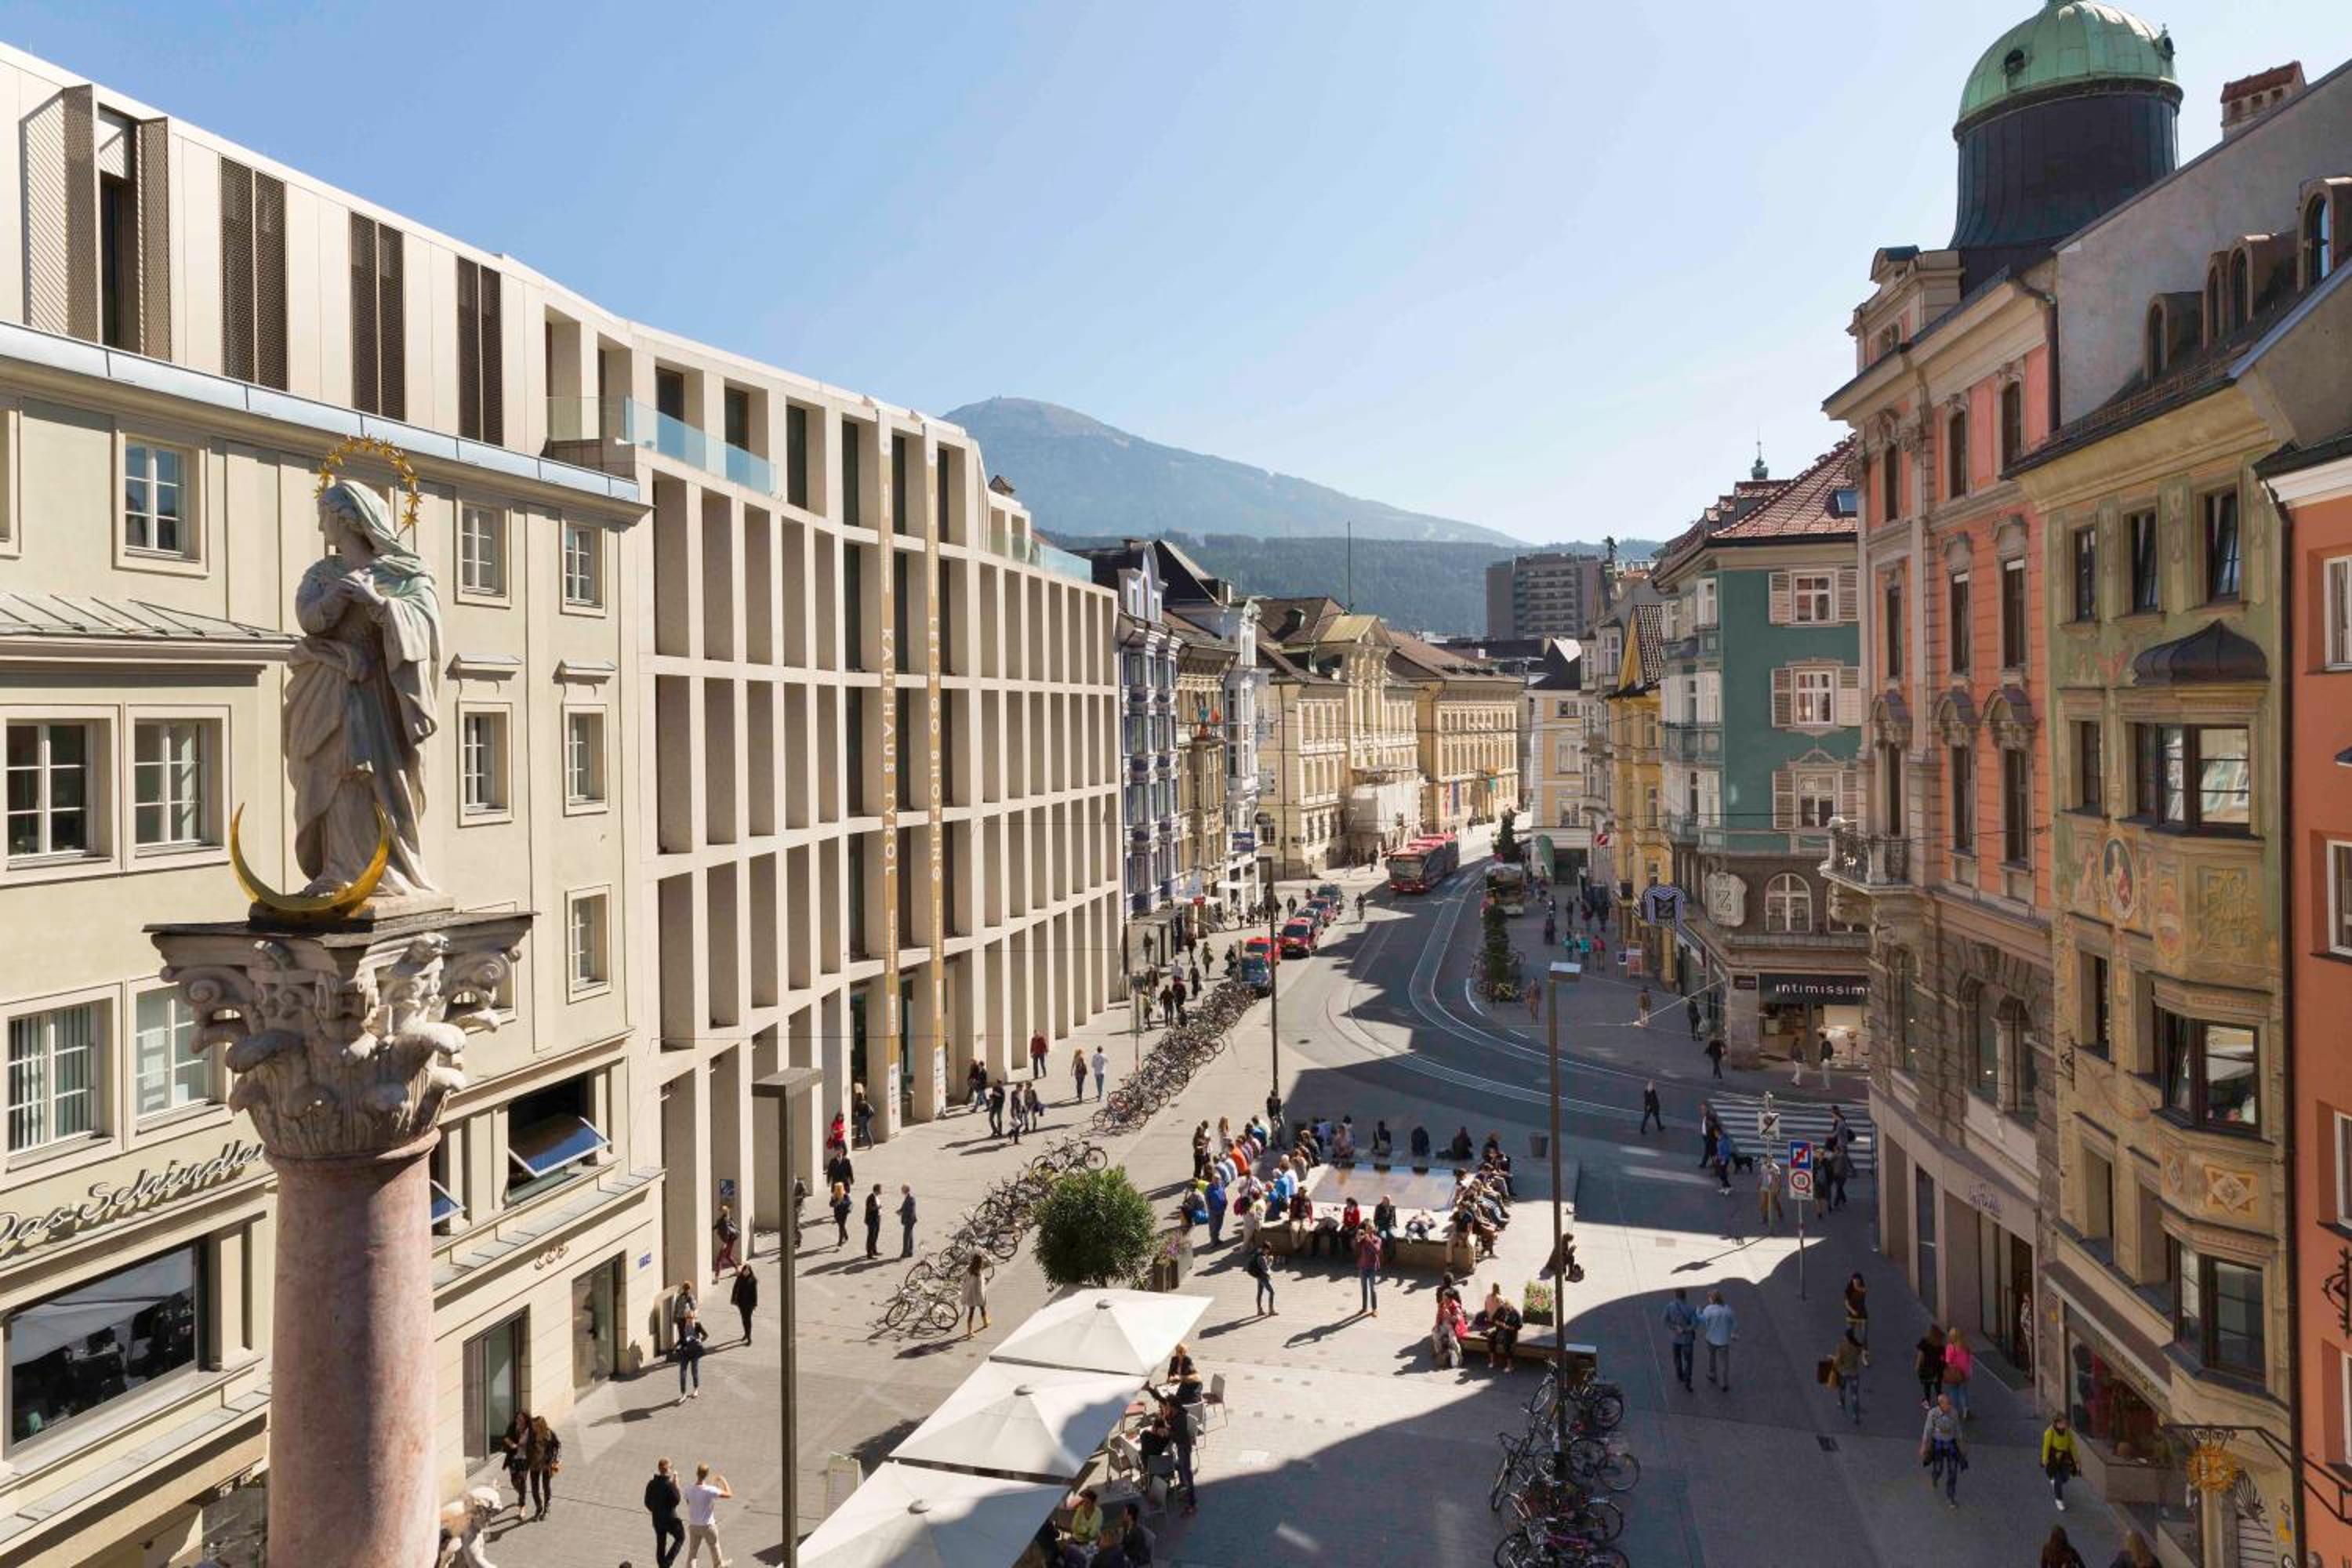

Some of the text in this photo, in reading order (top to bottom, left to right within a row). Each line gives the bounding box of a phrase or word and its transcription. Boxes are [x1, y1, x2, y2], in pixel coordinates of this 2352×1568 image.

[882, 628, 896, 876] KAUFHAUS TYROL
[931, 697, 940, 735] GO
[931, 750, 941, 880] SHOPPING
